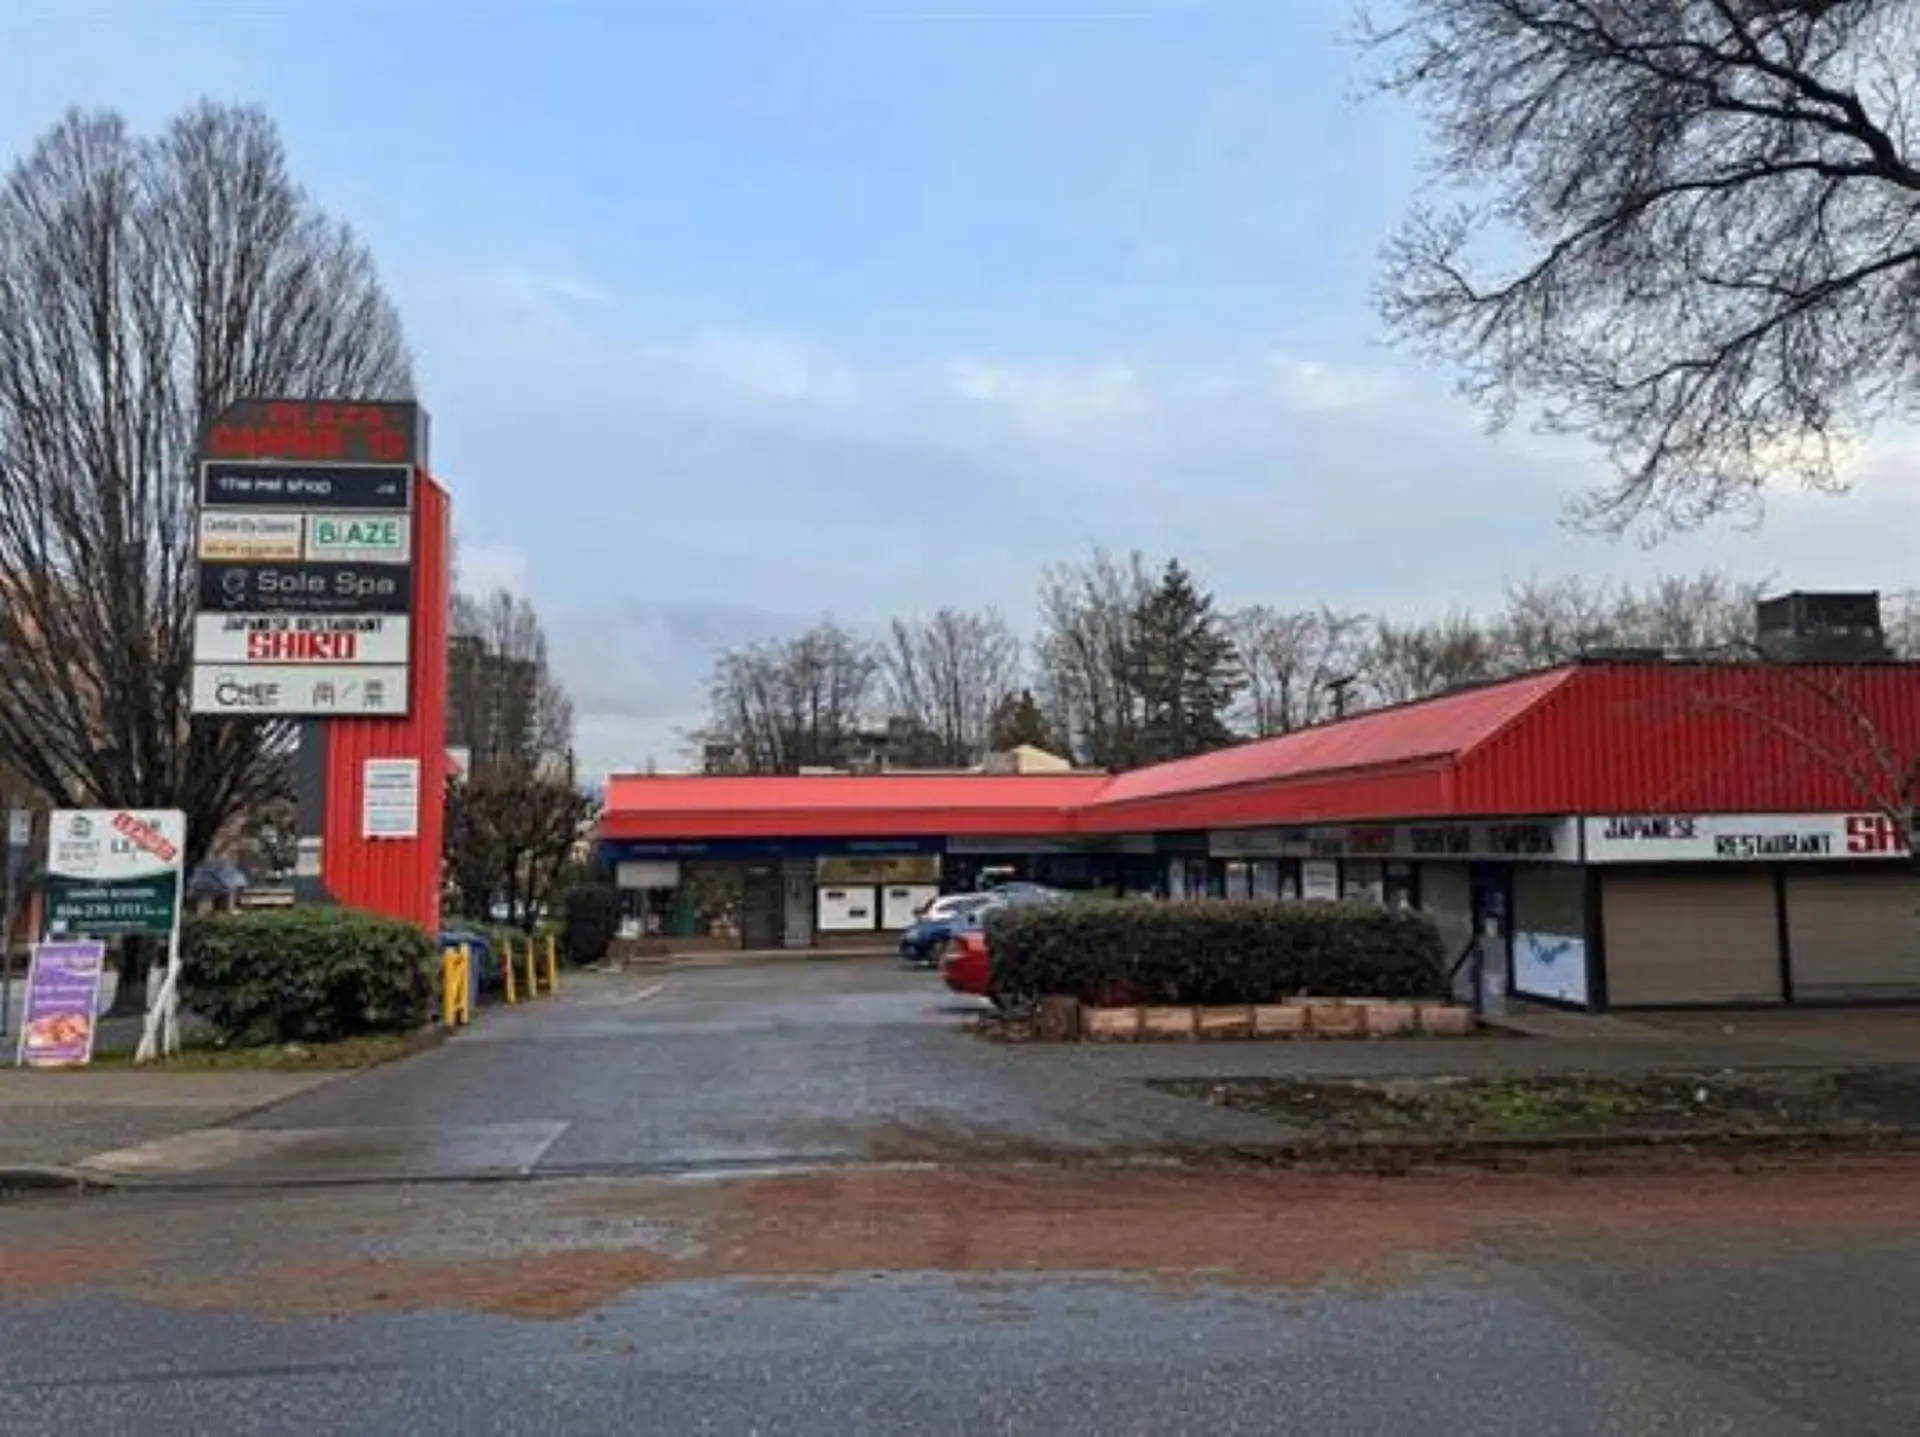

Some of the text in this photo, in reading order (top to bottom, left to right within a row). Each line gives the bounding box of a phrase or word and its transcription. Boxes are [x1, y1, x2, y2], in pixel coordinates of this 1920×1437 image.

[258, 569, 397, 596] Sole Spa
[223, 617, 383, 632] JAPANESE RESTAURANT
[247, 632, 356, 659] SHIRO
[1604, 816, 1698, 839] JAPANESE
[1714, 833, 1832, 855] RESTAURANT
